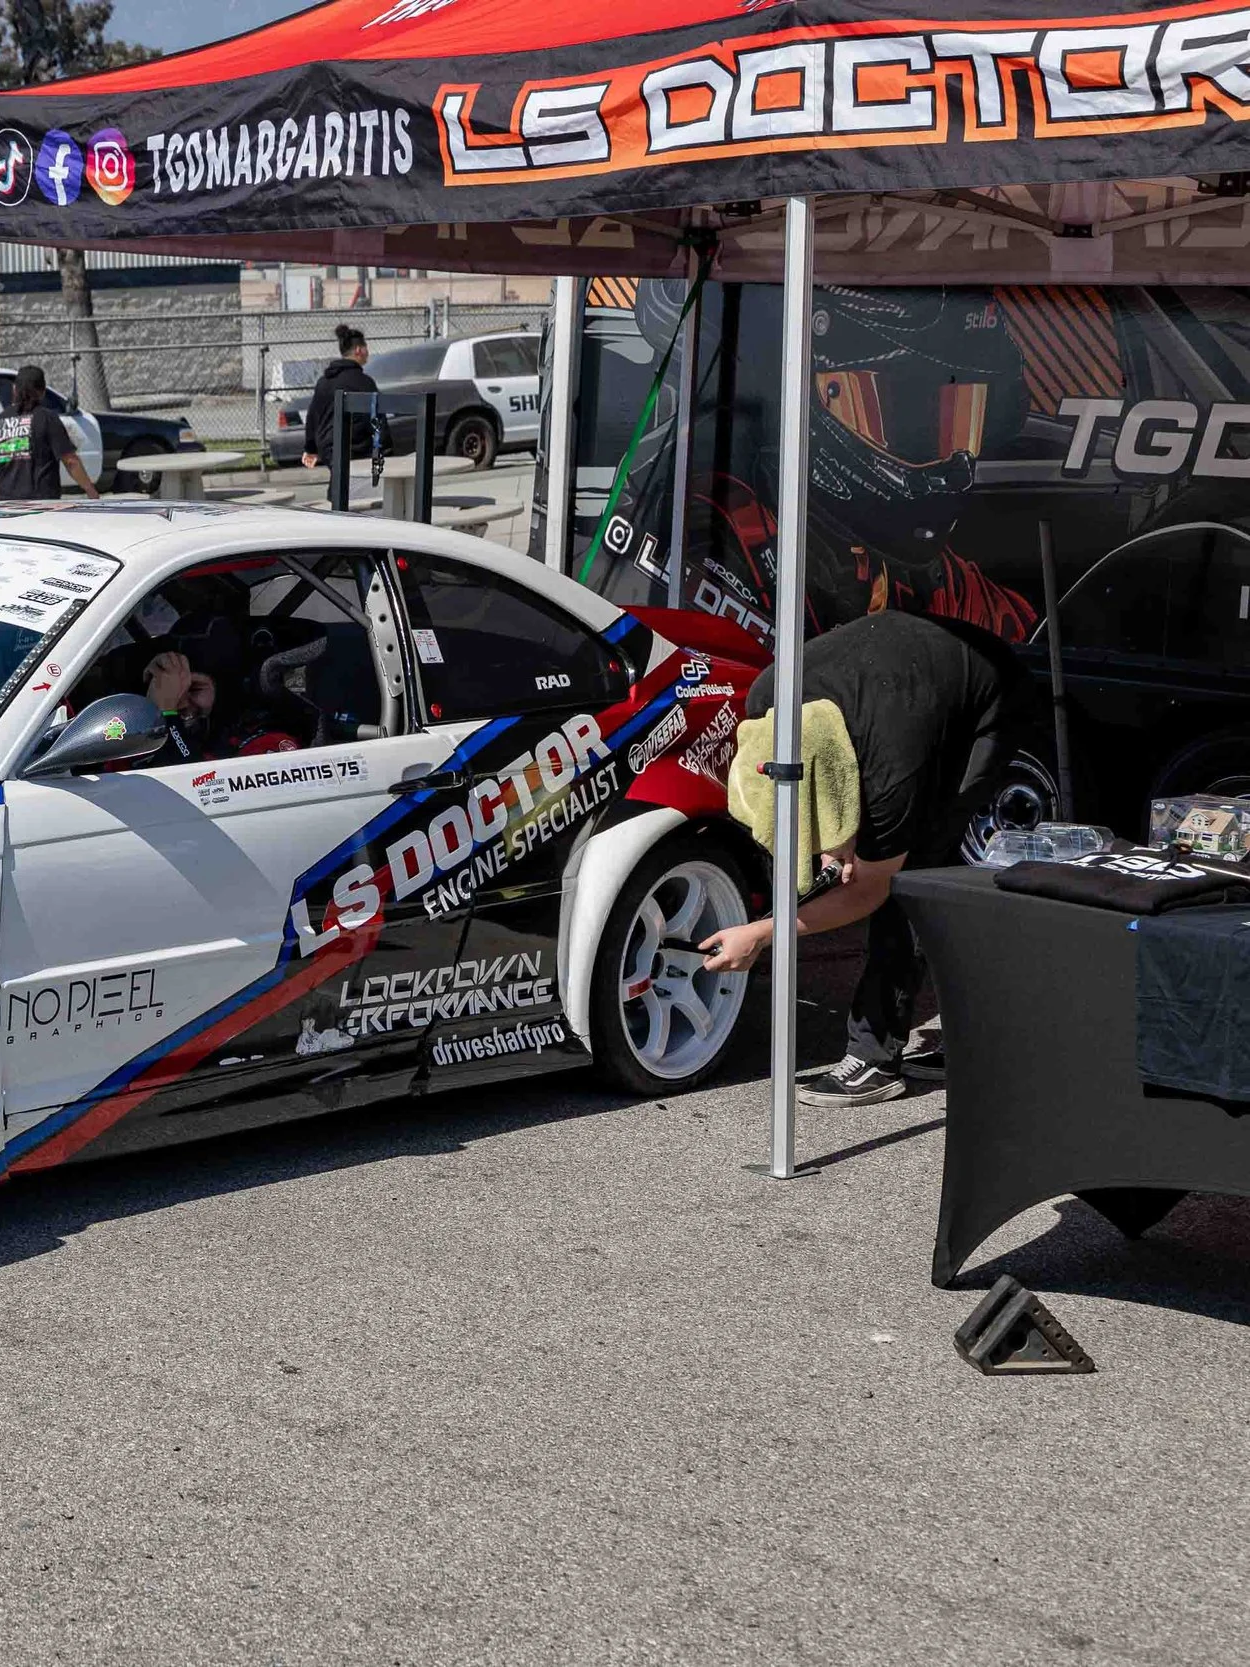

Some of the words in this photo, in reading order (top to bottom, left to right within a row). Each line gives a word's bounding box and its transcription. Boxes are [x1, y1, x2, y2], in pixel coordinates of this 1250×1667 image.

[446, 81, 610, 171] LS
[643, 11, 1250, 154] DOCTOR
[535, 674, 571, 690] RAD
[675, 683, 735, 698] ColorFittings
[644, 706, 687, 763] WISEFAB
[678, 700, 733, 770] CATALYST
[228, 764, 333, 792] MARGARITIS
[337, 761, 359, 777] 75
[291, 864, 380, 958] LS
[386, 714, 612, 901] DOCTOR
[422, 842, 509, 921] ENGINE
[512, 761, 620, 861] SPECIALIST
[339, 951, 541, 1007] LOCKDOWN
[6, 1010, 163, 1045] GRAPHICS
[432, 1022, 565, 1066] driveshaftpro
